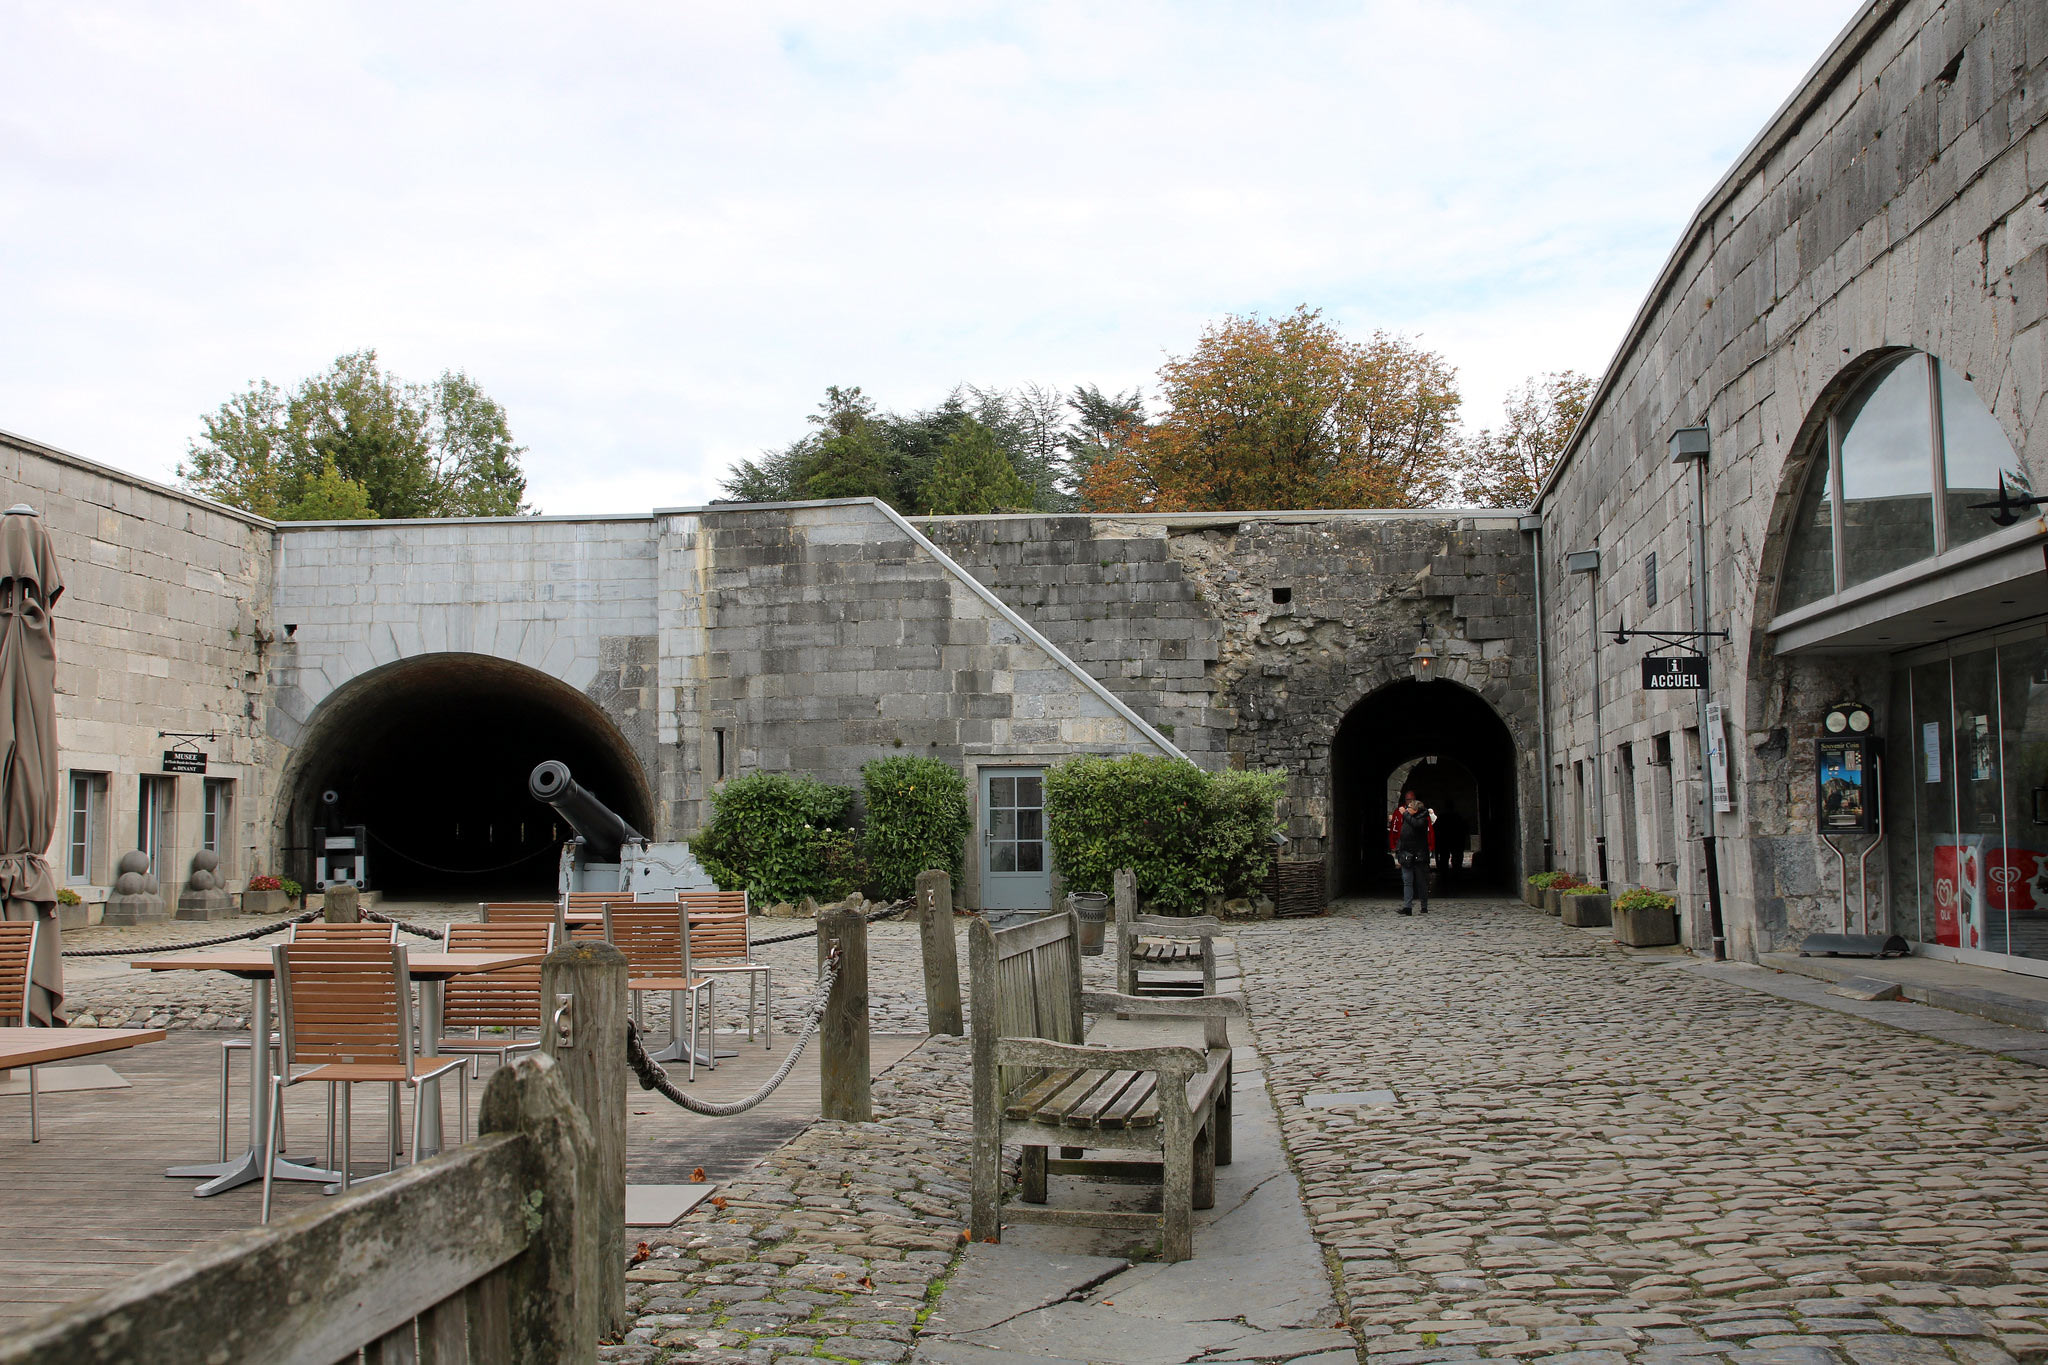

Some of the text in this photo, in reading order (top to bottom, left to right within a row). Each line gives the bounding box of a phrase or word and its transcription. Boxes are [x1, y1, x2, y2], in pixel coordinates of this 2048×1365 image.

[1650, 674, 1701, 688] ACCUEIL
[1996, 885, 2016, 893] OA
[1940, 909, 1951, 921] OLA
